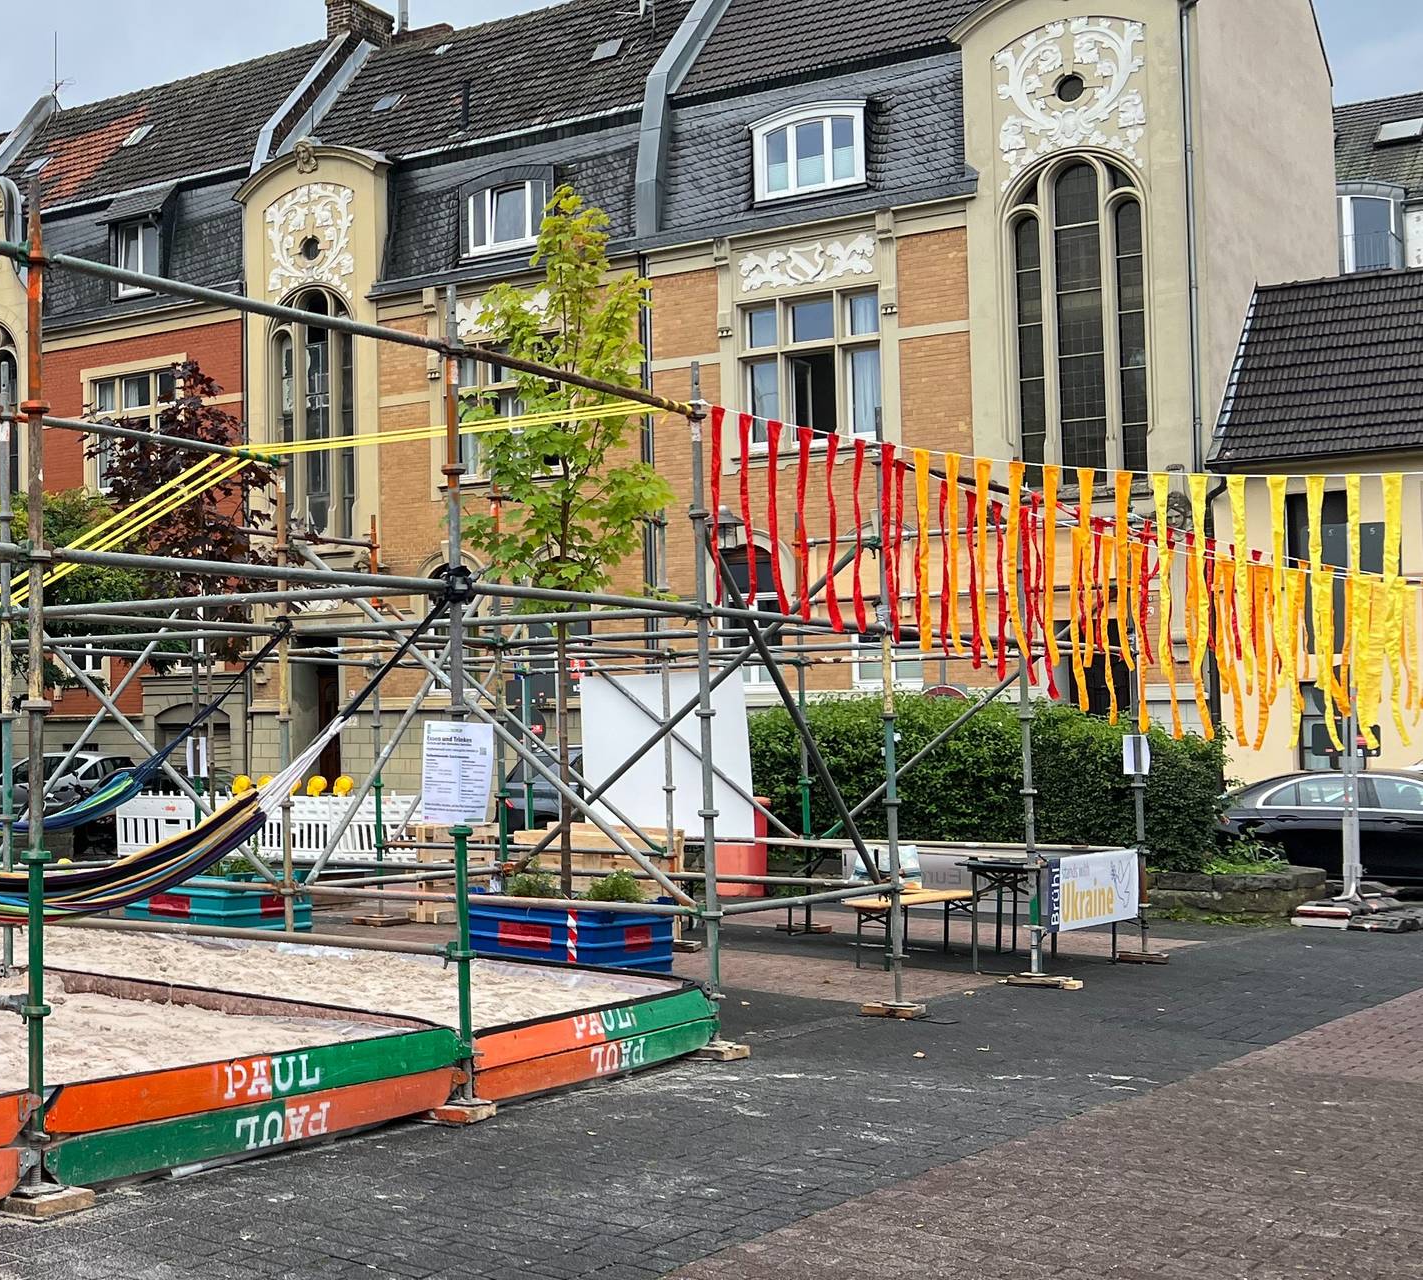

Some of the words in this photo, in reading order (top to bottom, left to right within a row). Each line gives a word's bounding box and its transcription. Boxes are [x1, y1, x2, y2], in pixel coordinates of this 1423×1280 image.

[1050, 867, 1060, 926] Brühl
[1061, 877, 1114, 923] Ukraine
[573, 1008, 632, 1039] PAUL
[223, 1054, 320, 1099] PAUL
[590, 1038, 646, 1073] PAUL
[236, 1101, 331, 1150] PAUL
